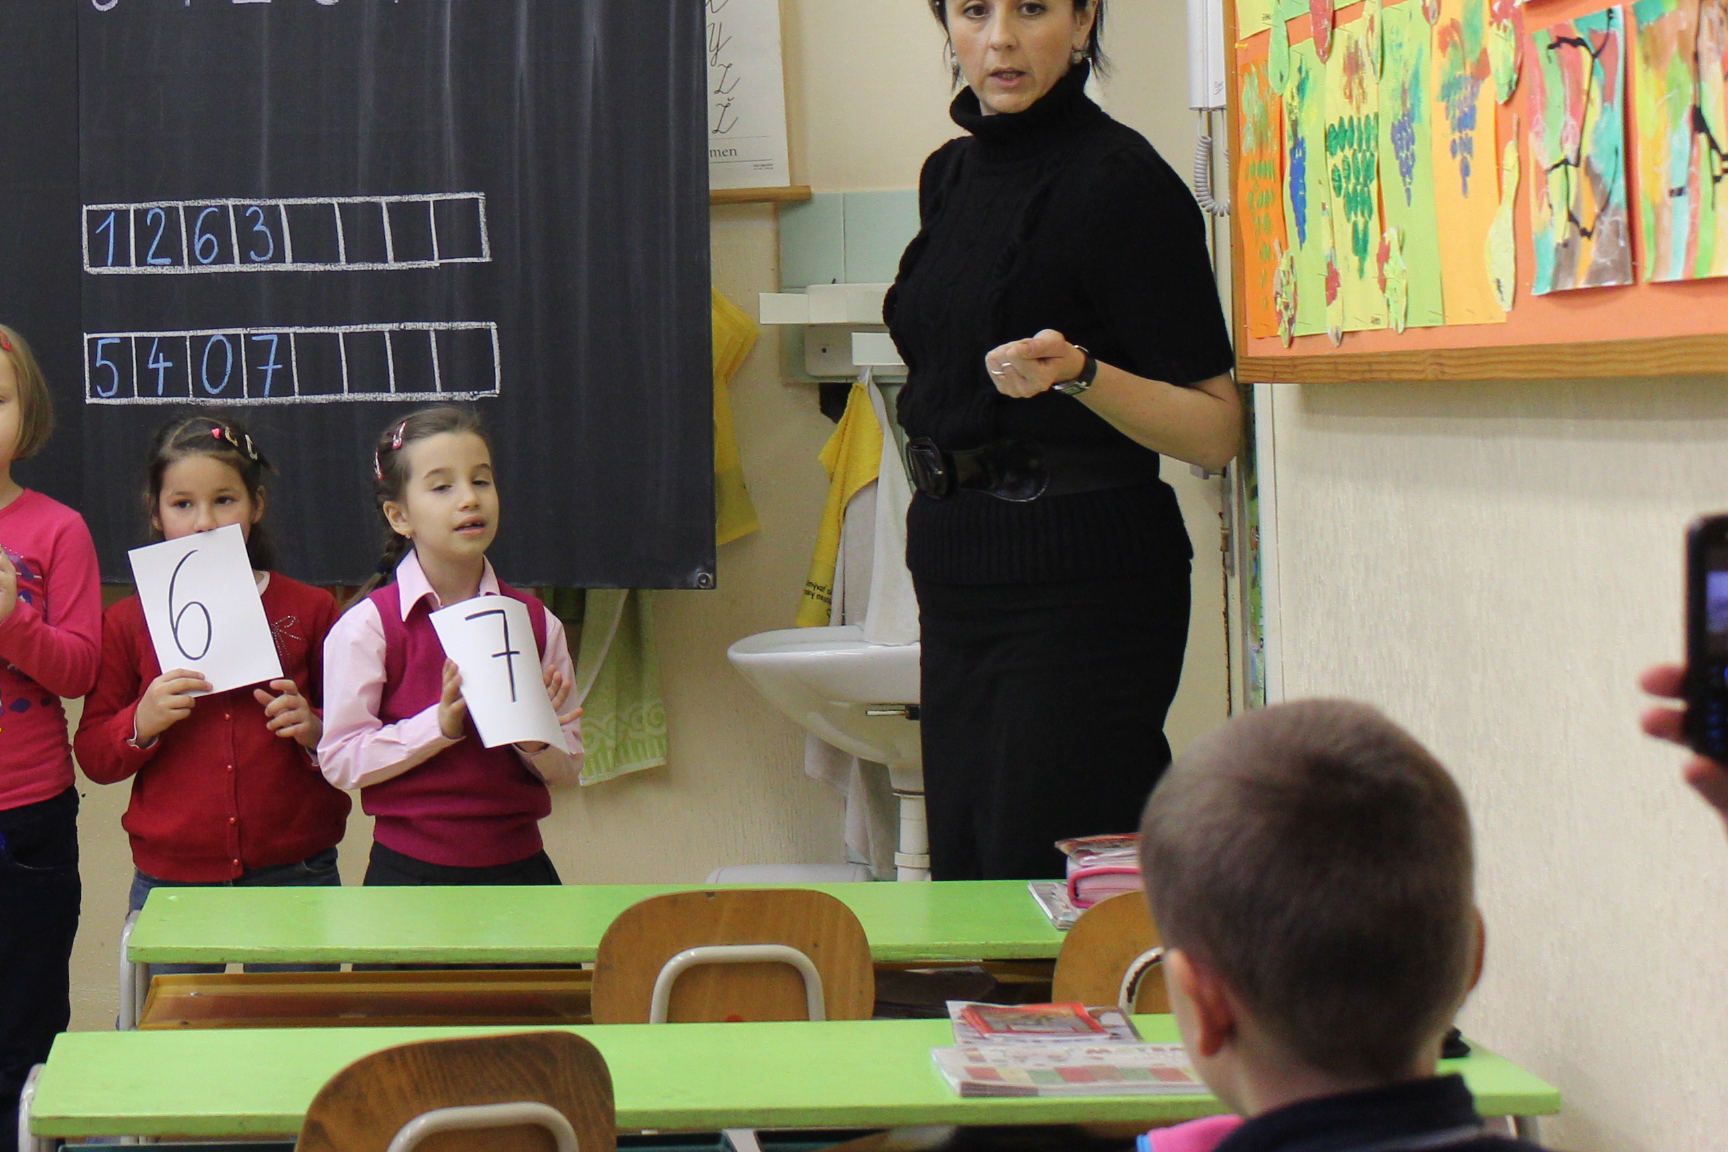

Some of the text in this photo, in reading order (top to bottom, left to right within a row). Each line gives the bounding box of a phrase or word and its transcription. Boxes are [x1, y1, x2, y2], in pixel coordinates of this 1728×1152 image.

[96, 206, 272, 266] 1 2 6 3
[96, 334, 281, 398] 5 4 0 7
[169, 550, 212, 660] 6
[460, 609, 520, 705] 7
